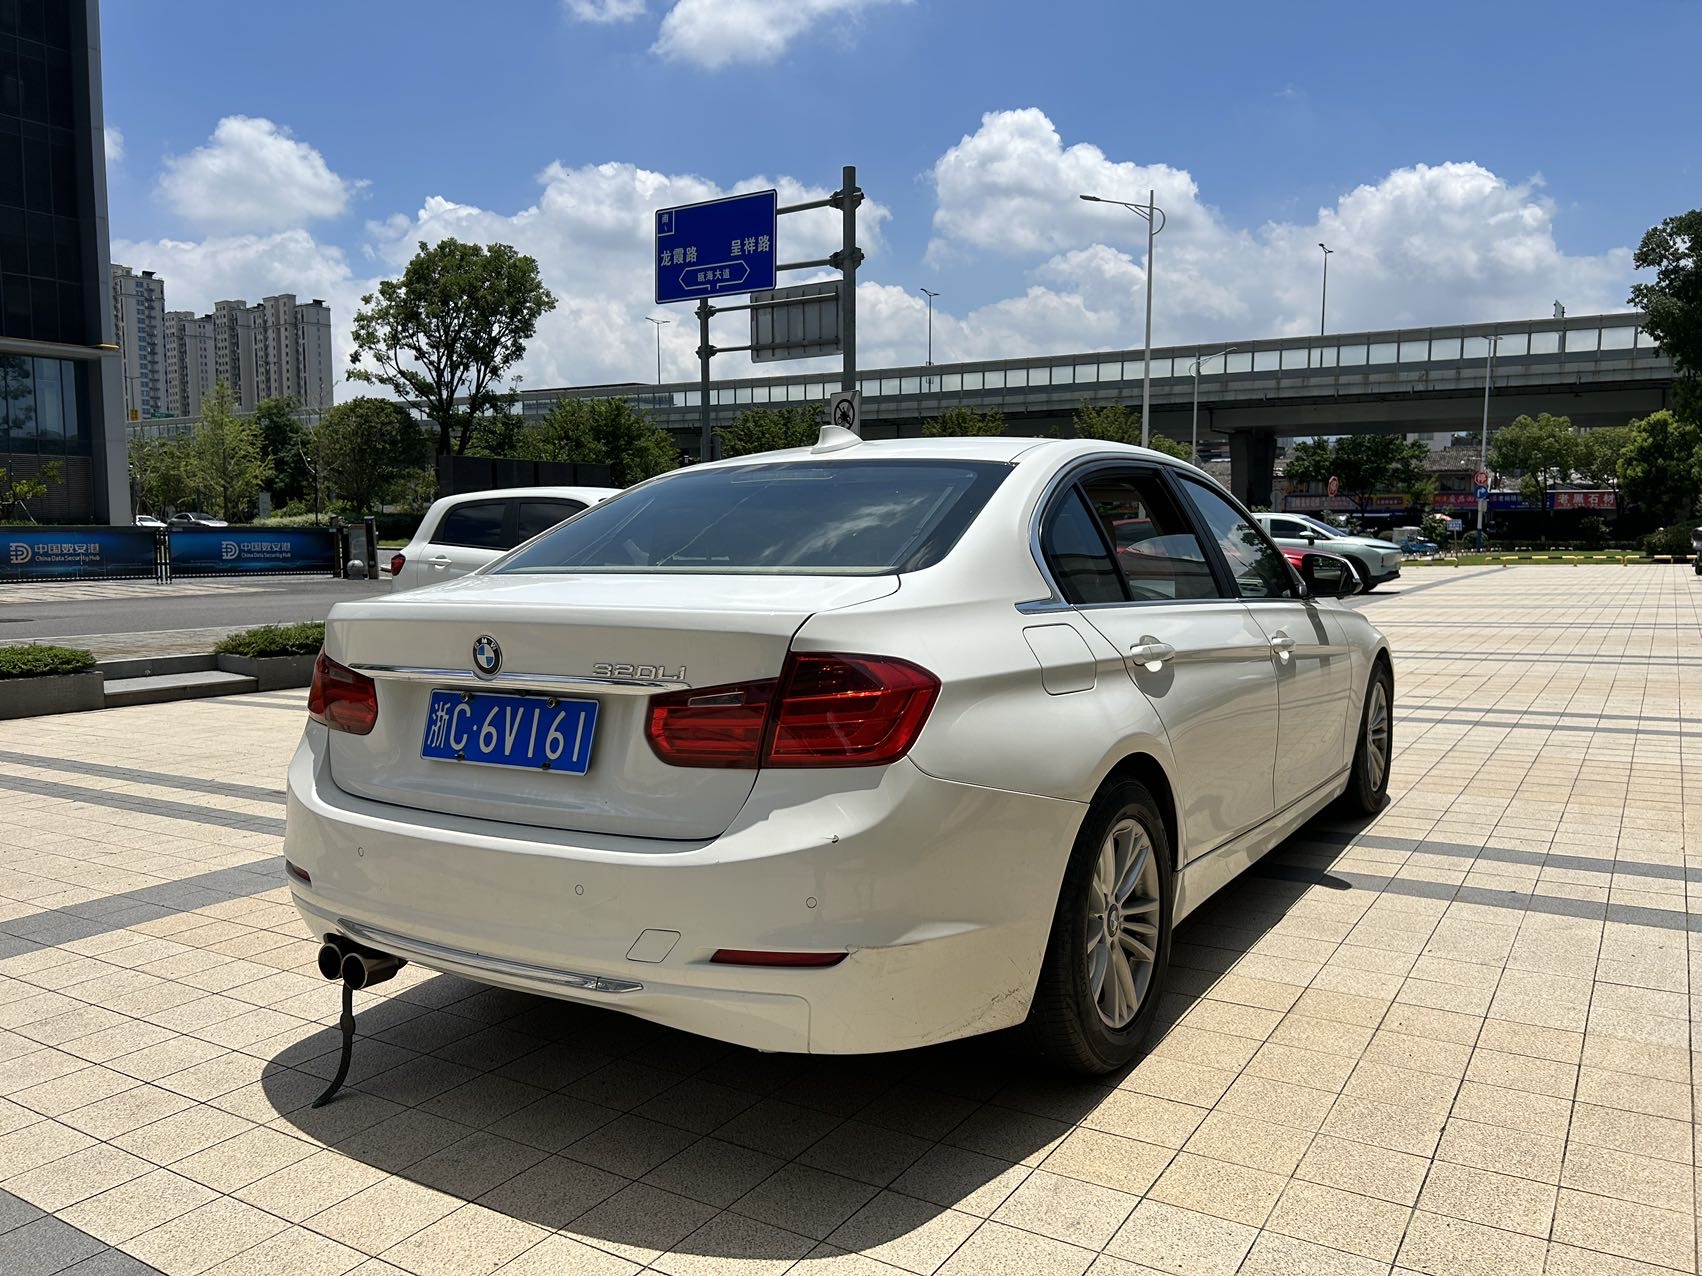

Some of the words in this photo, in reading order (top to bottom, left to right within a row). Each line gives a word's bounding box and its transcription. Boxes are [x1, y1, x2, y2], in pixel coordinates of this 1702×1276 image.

[730, 235, 770, 256] 呈祥路
[660, 246, 698, 266] 龙霞路
[697, 269, 730, 282] 瓯海大道
[34, 543, 100, 554] 中国数安港
[240, 542, 291, 552] 中国数安港
[592, 662, 687, 681] 320Li
